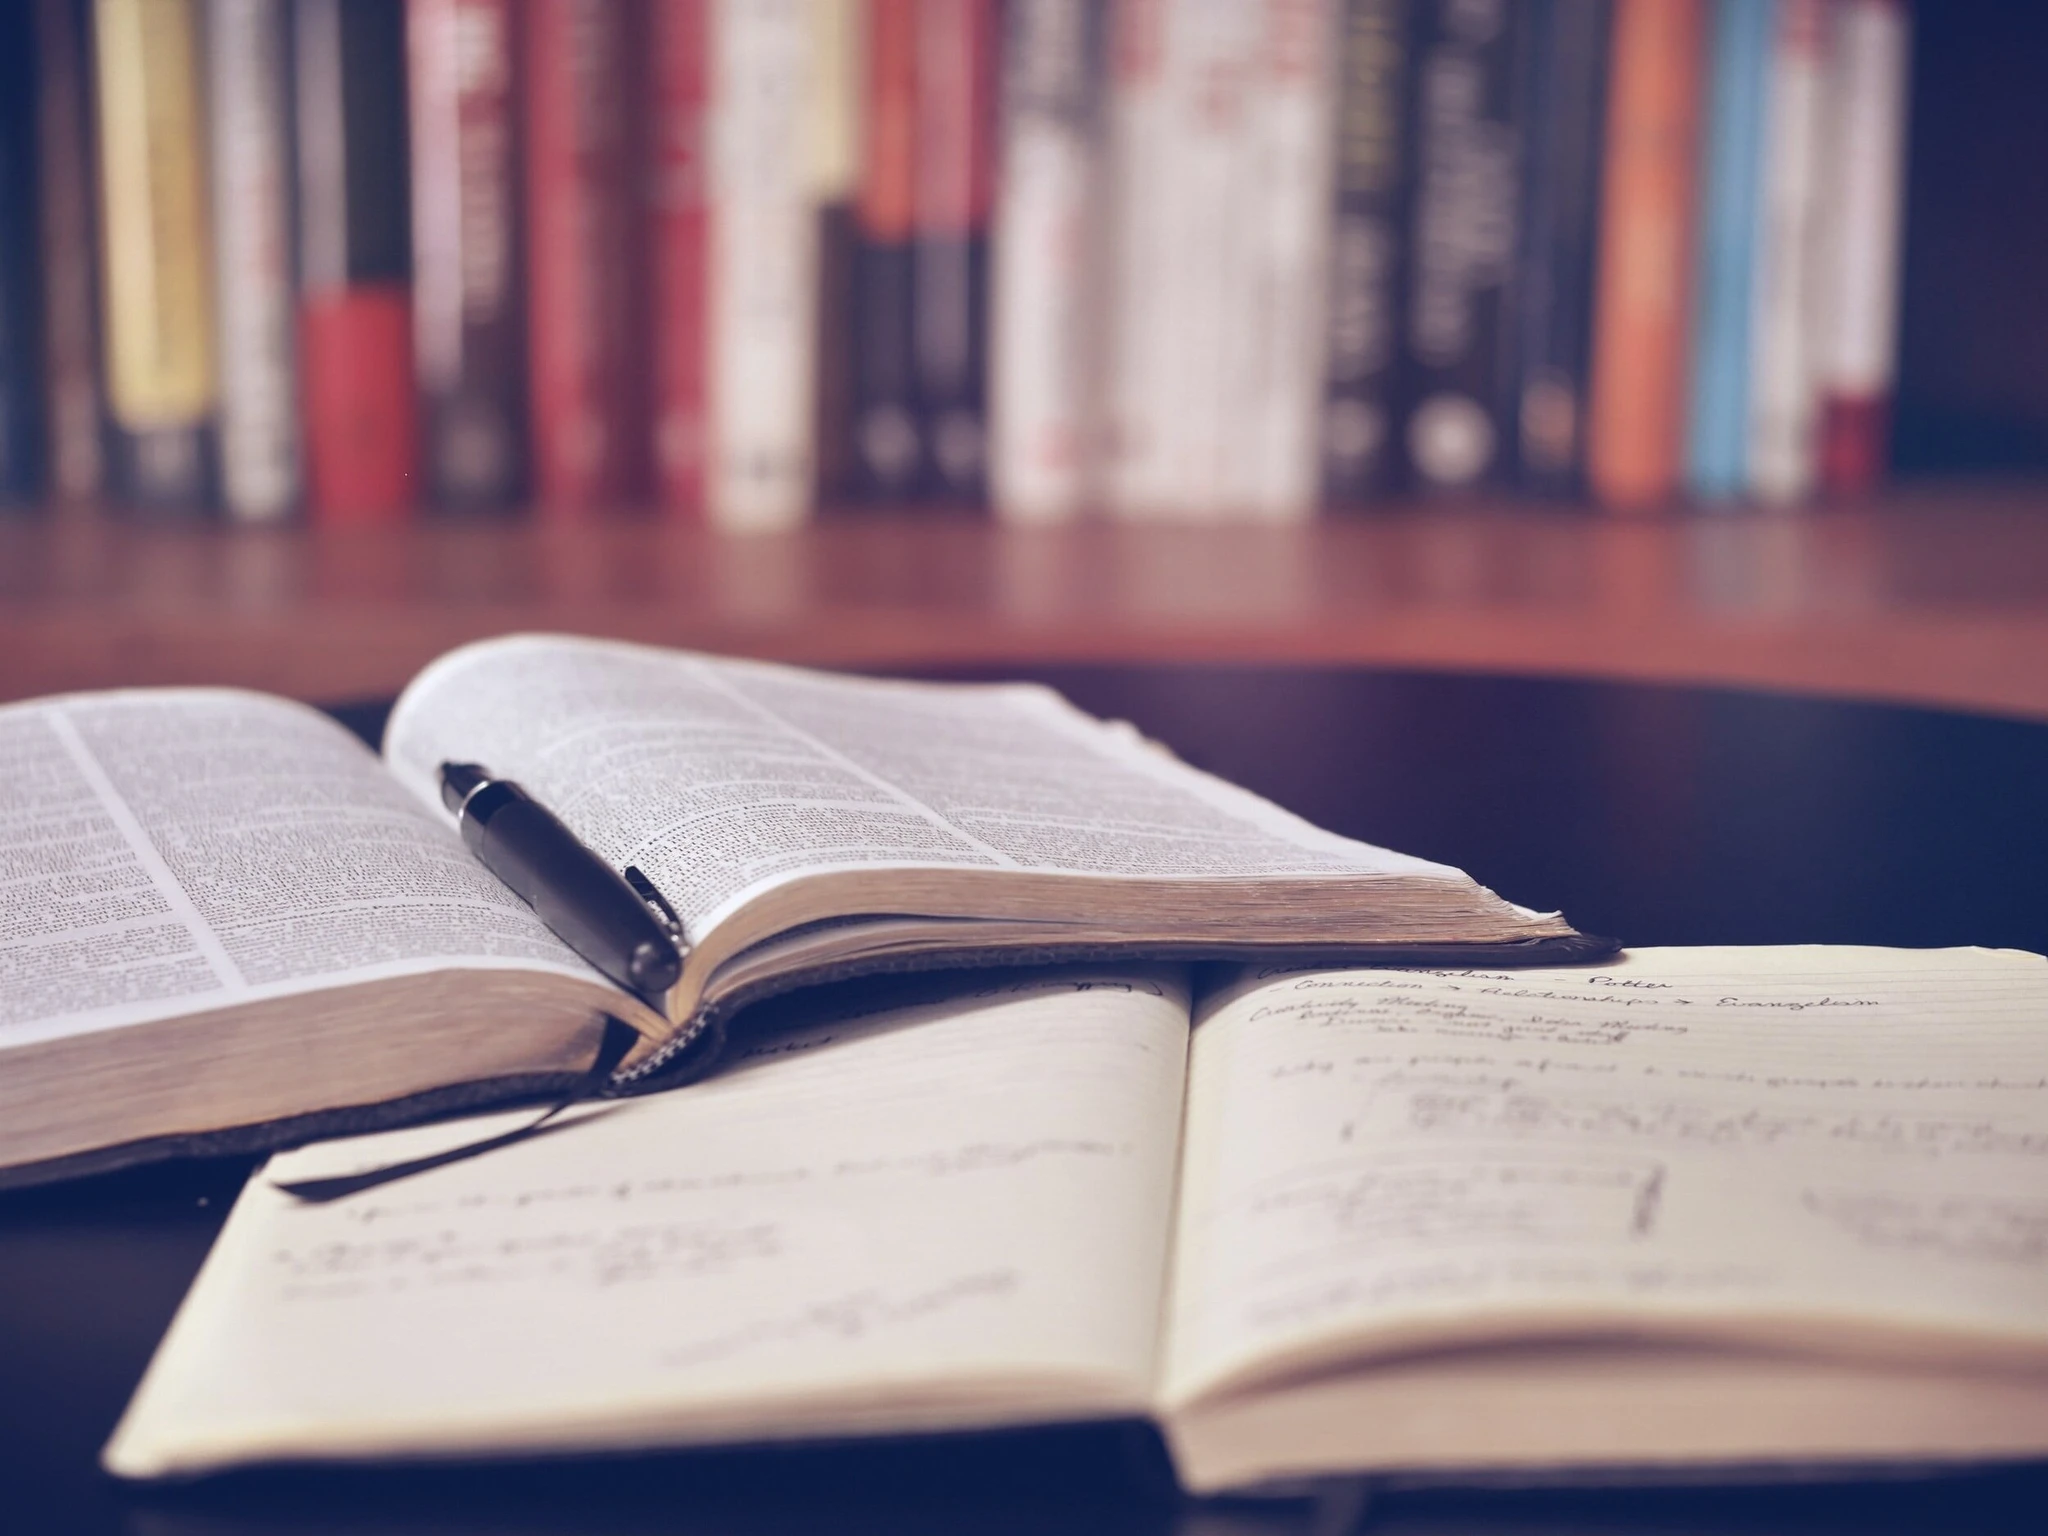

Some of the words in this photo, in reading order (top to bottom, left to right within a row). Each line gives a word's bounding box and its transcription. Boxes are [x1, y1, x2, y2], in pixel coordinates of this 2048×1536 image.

[1588, 976, 1673, 989] Potter
[1295, 979, 1424, 990] Connection
[1480, 986, 1659, 1006] Relationships
[1716, 996, 1880, 1011] Evangelism
